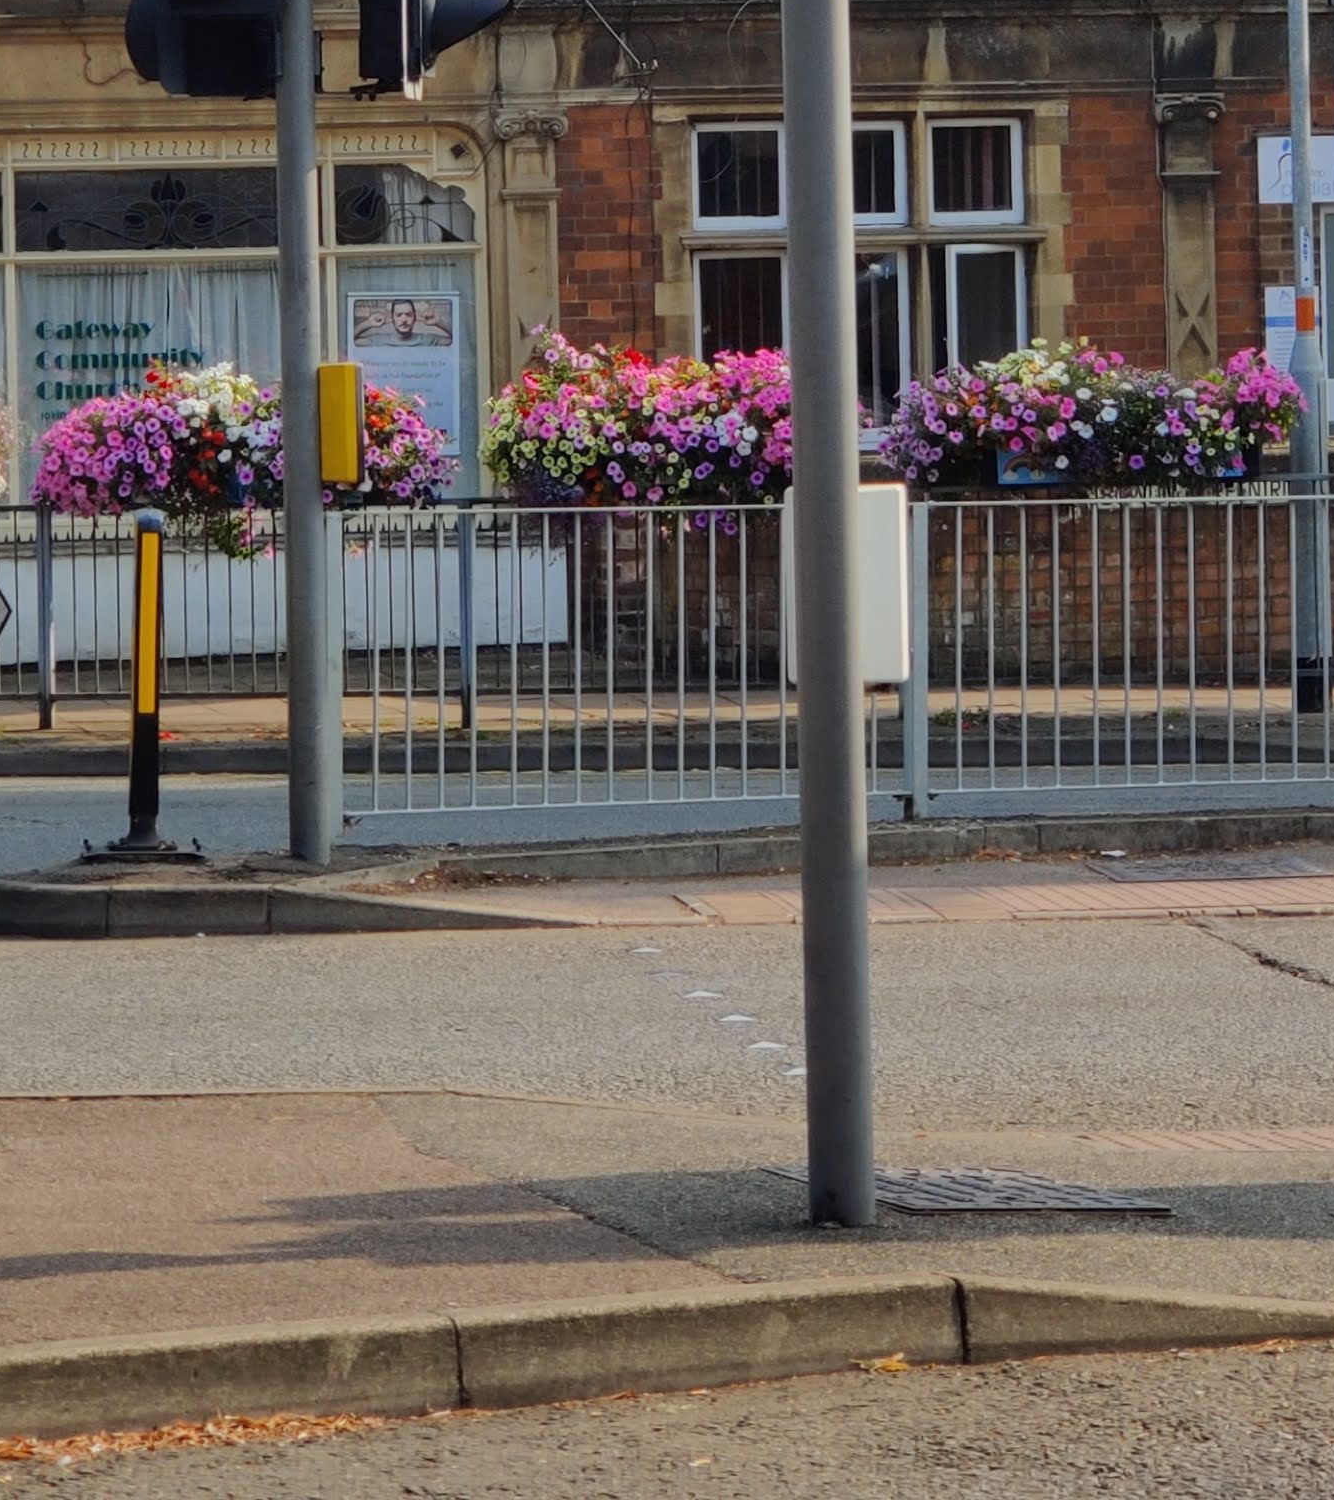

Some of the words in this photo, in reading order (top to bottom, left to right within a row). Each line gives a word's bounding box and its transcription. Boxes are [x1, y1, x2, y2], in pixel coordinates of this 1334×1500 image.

[36, 320, 156, 340] Gateway
[36, 348, 205, 370] Community
[36, 380, 141, 400] Church
